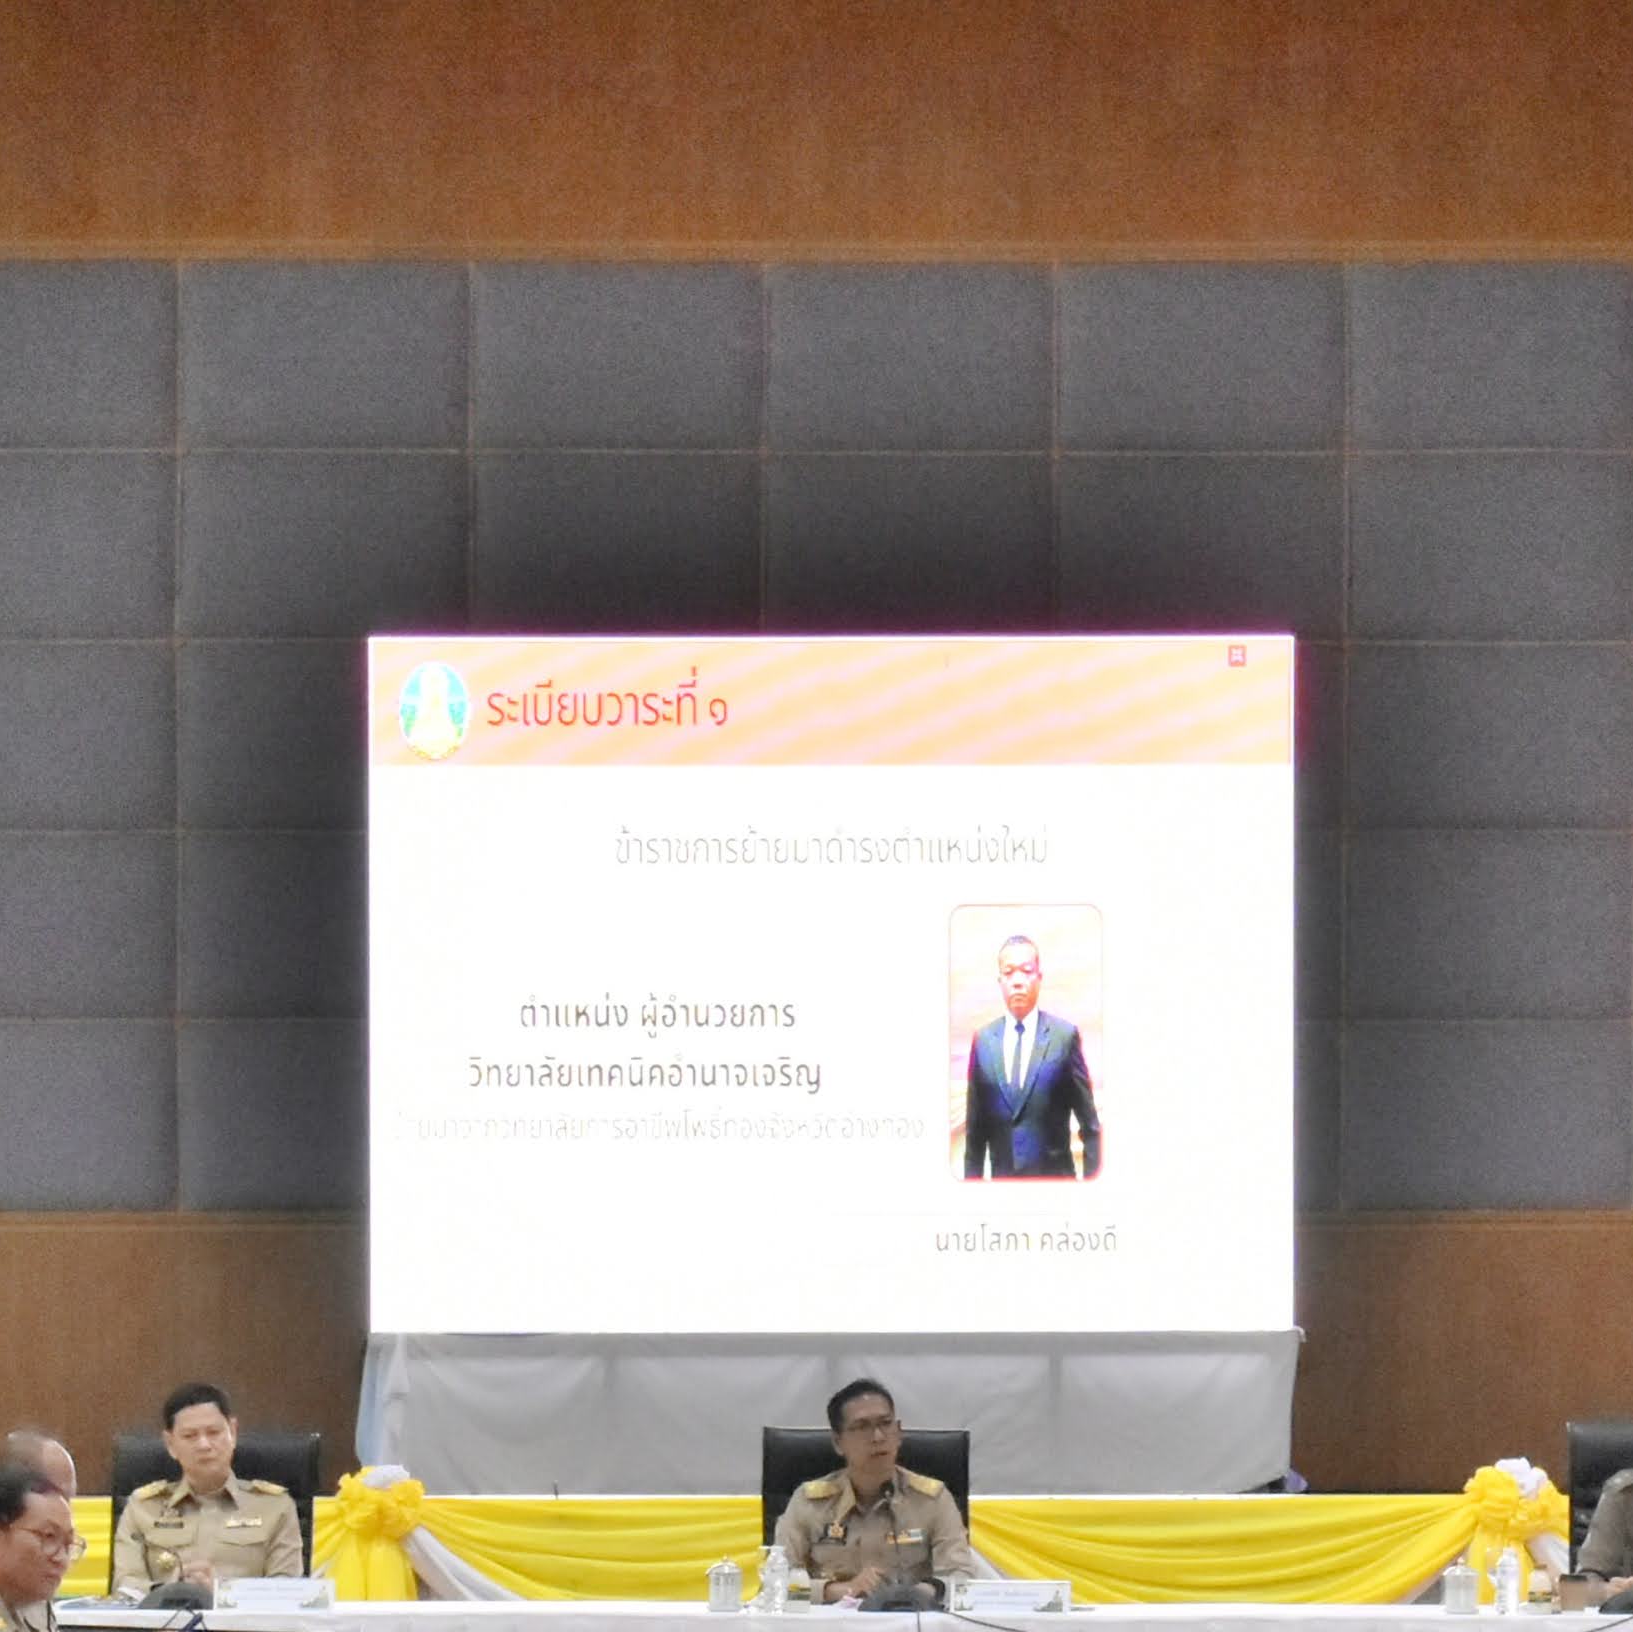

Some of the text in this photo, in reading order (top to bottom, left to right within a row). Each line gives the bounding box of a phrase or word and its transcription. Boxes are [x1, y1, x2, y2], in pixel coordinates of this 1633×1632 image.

[487, 666, 728, 726] ระเบียบวาระที่ ๑
[521, 992, 796, 1038] ตำแหน่ง ผู้อำนวยการ
[469, 1053, 822, 1095] วิทยาลัยเทคนิคอำนาจเจริญ
[1040, 1221, 1117, 1252] คล่องดี
